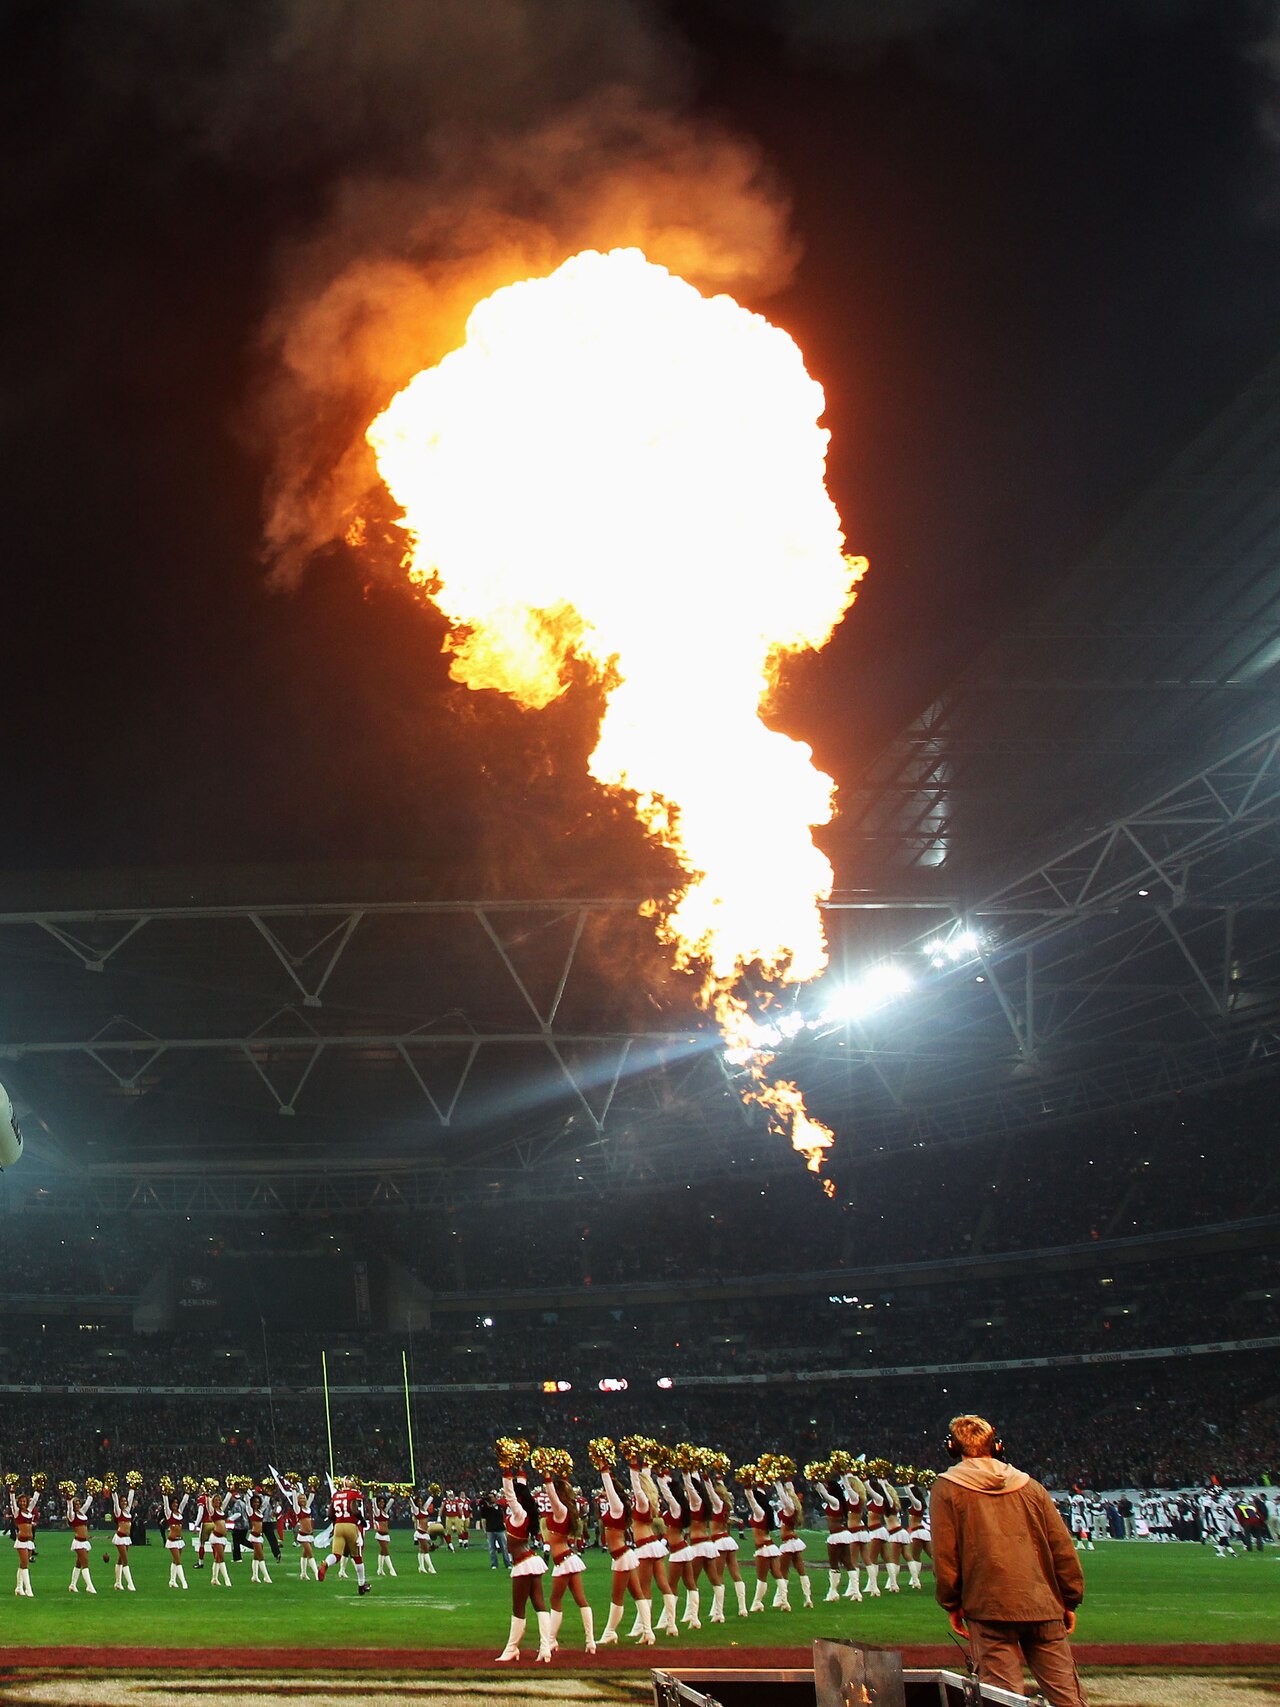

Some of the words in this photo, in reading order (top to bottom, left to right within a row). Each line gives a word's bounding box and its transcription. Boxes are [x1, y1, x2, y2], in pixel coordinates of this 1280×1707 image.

[879, 1367, 898, 1376] VISA
[73, 1385, 99, 1393] Canon
[136, 1386, 152, 1394] VISA
[369, 1385, 385, 1393] VISA
[333, 1499, 351, 1518] 51
